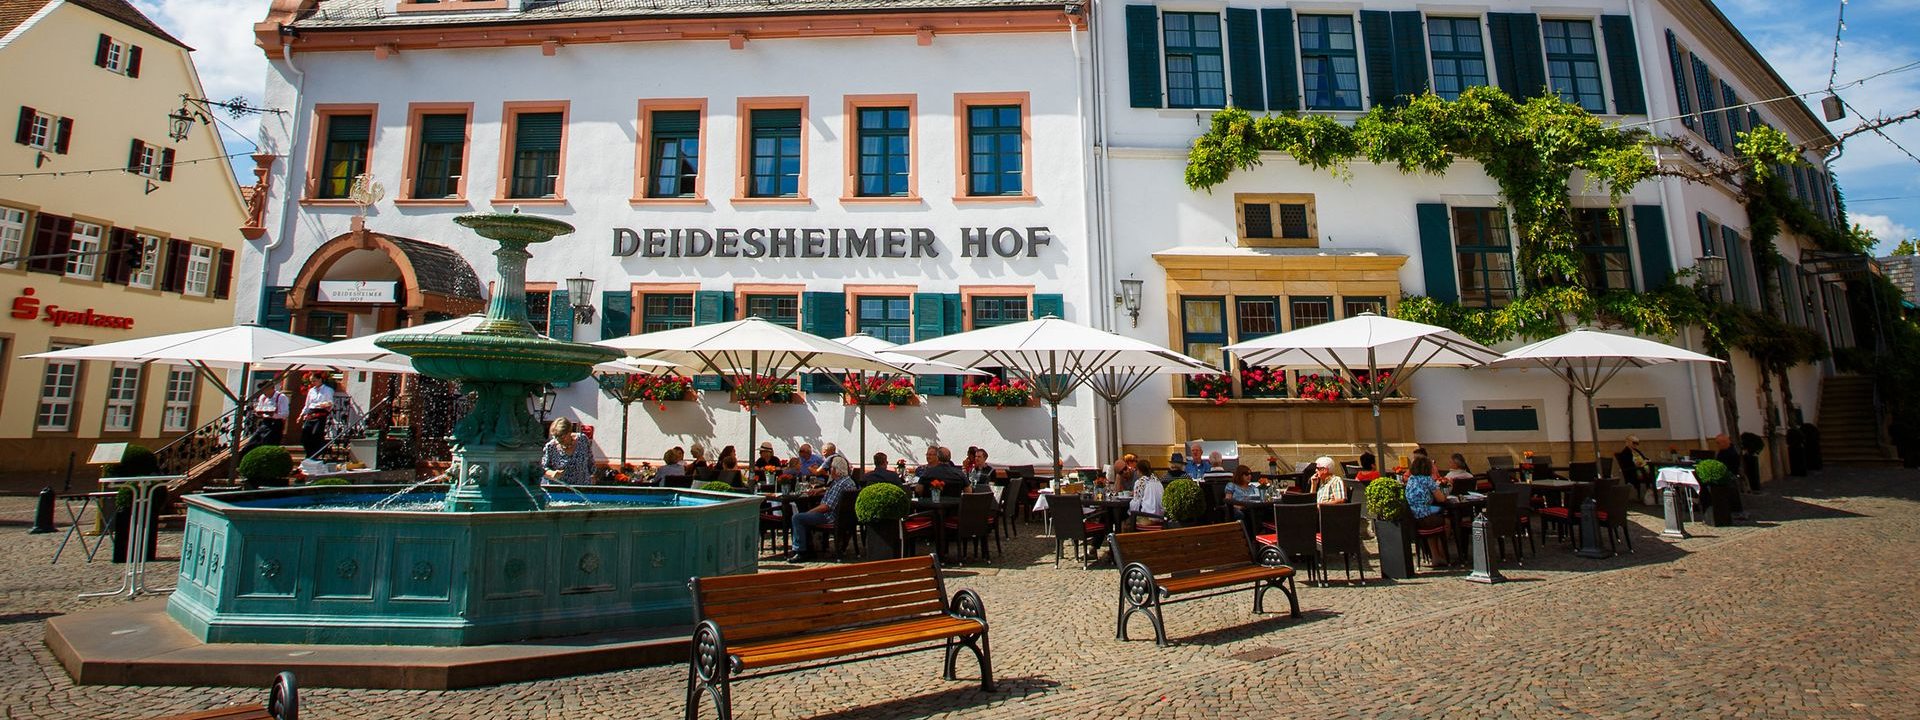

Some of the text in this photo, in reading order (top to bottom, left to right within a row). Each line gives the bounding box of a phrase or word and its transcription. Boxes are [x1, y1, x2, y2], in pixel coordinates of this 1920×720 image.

[612, 226, 1051, 258] DEIDESHEIMER HOF
[42, 304, 135, 329] Sparkasse
